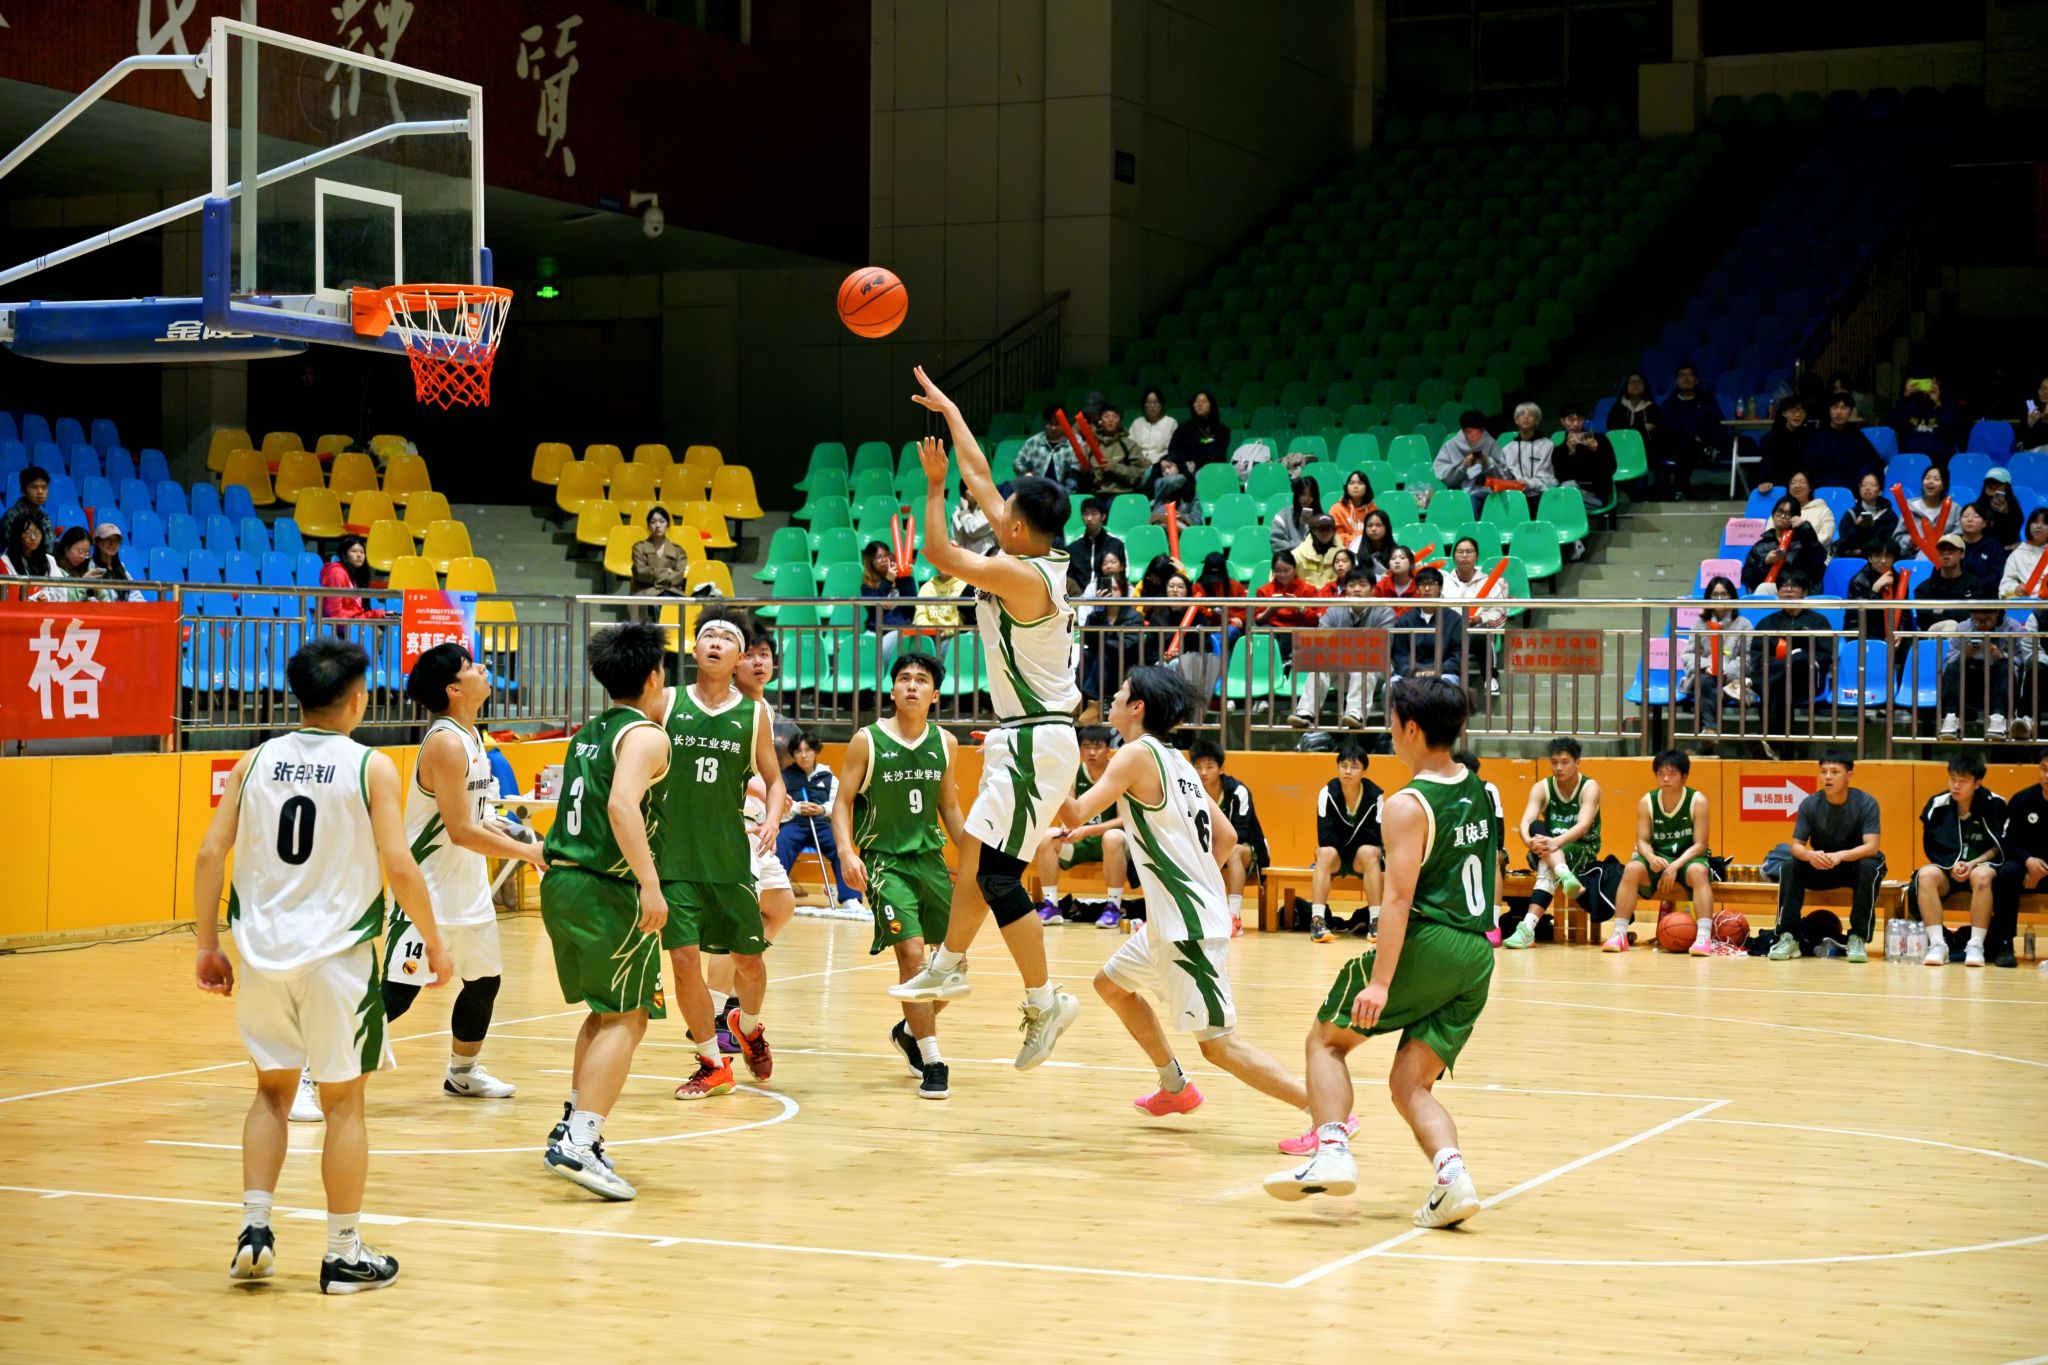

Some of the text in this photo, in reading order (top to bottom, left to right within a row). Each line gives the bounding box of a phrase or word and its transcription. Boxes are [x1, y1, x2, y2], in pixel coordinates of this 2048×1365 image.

[28, 618, 107, 720] 格
[673, 734, 741, 755] 长沙工业学院
[694, 756, 719, 784] 13
[882, 768, 942, 783] 长沙工业学院
[566, 775, 585, 836] 3
[908, 788, 923, 814] 9
[1753, 792, 1793, 804] 离场路线
[276, 795, 317, 866] 0
[1461, 854, 1486, 917] 0
[884, 904, 895, 921] 9
[405, 941, 424, 960] 14
